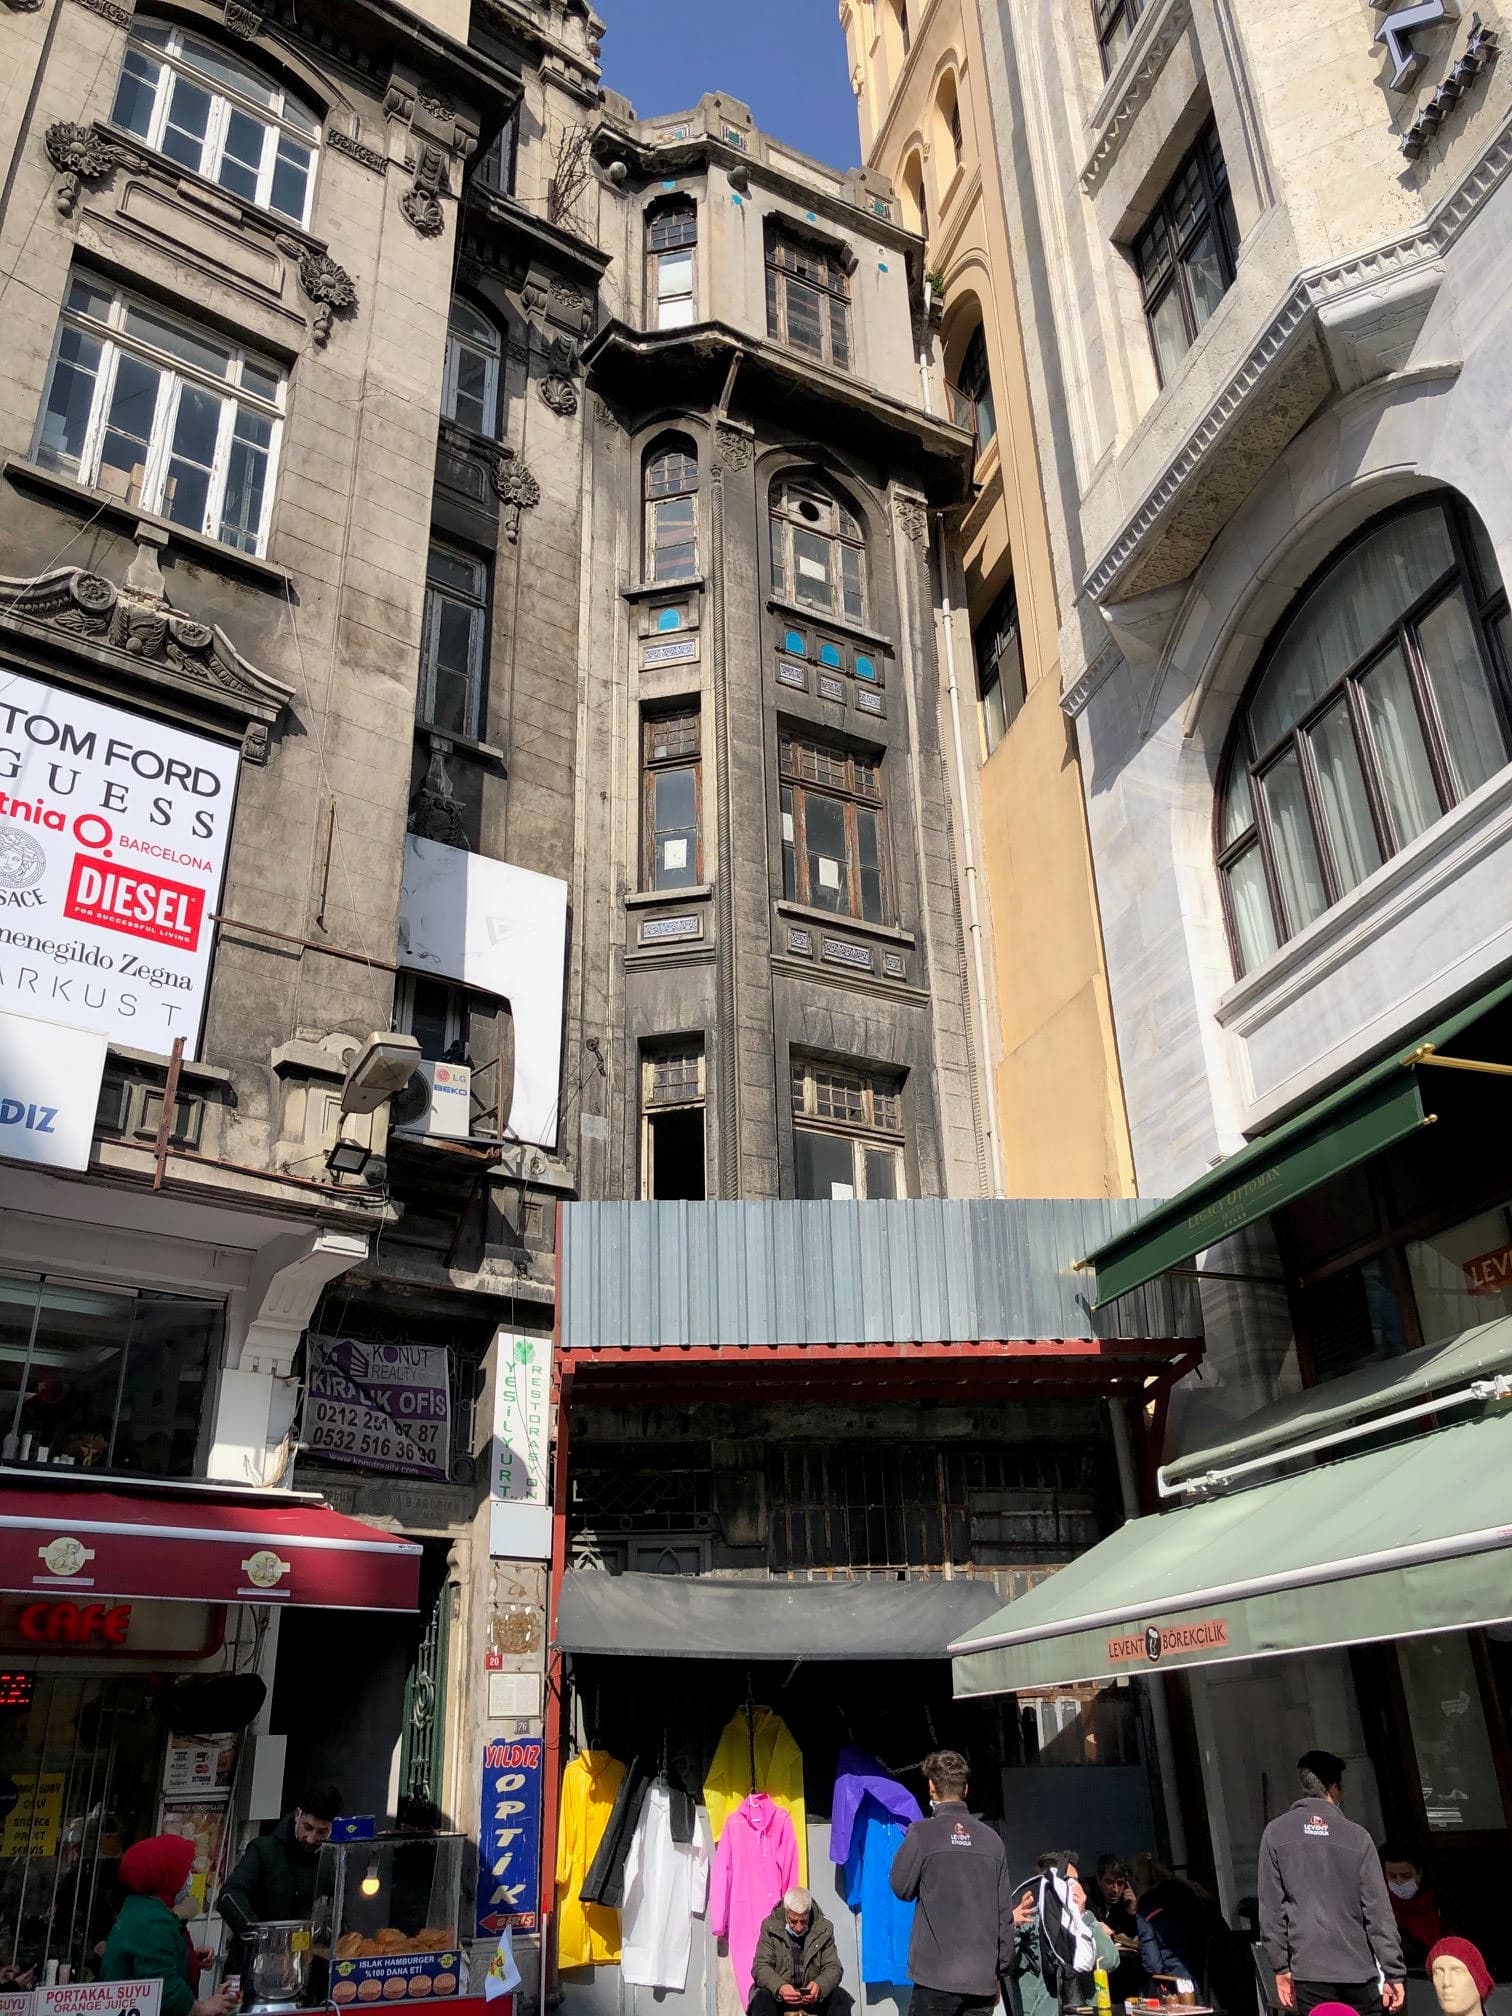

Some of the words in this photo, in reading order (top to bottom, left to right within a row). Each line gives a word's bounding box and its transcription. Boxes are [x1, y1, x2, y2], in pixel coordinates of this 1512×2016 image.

[0, 702, 97, 760] TOM
[104, 738, 221, 798] FORD
[0, 747, 215, 839] GUESS
[119, 834, 214, 874] BARCELONA
[76, 865, 192, 934] DIESEL
[74, 906, 94, 917] FOR
[96, 913, 156, 934] SUCCESSFUL
[159, 930, 191, 943] LIVING
[118, 953, 193, 992] Zegna
[433, 1084, 468, 1096] BEKO
[452, 1073, 467, 1083] LG
[0, 1098, 59, 1134] DIZ
[371, 1364, 418, 1381] REALTY
[373, 1345, 431, 1368] KONUT
[400, 1389, 447, 1416] OFİS
[317, 1403, 358, 1427] 0212
[418, 1424, 439, 1443] 87
[525, 1365, 543, 1501] RESTORASYON
[313, 1426, 357, 1450] 0532
[360, 1436, 391, 1457] 516
[396, 1444, 414, 1461] 36
[18, 1601, 132, 1644] CAFE
[1108, 1638, 1145, 1658] LEVENT
[1162, 1622, 1226, 1650] BÖREKÇİLİK
[489, 1657, 500, 1667] 20
[485, 1745, 540, 1769] YILDIZ
[359, 1959, 383, 1969] ISLAK
[384, 1955, 435, 1967] HAMBURGER
[365, 1969, 385, 1978] %100
[386, 1967, 408, 1976] DANA
[409, 1964, 422, 1974] ETİ
[46, 1988, 113, 2004] PORTAKAL
[117, 1985, 151, 1999] SUYU
[53, 2001, 102, 2014] ORANGE
[104, 1998, 137, 2010] JUICE
